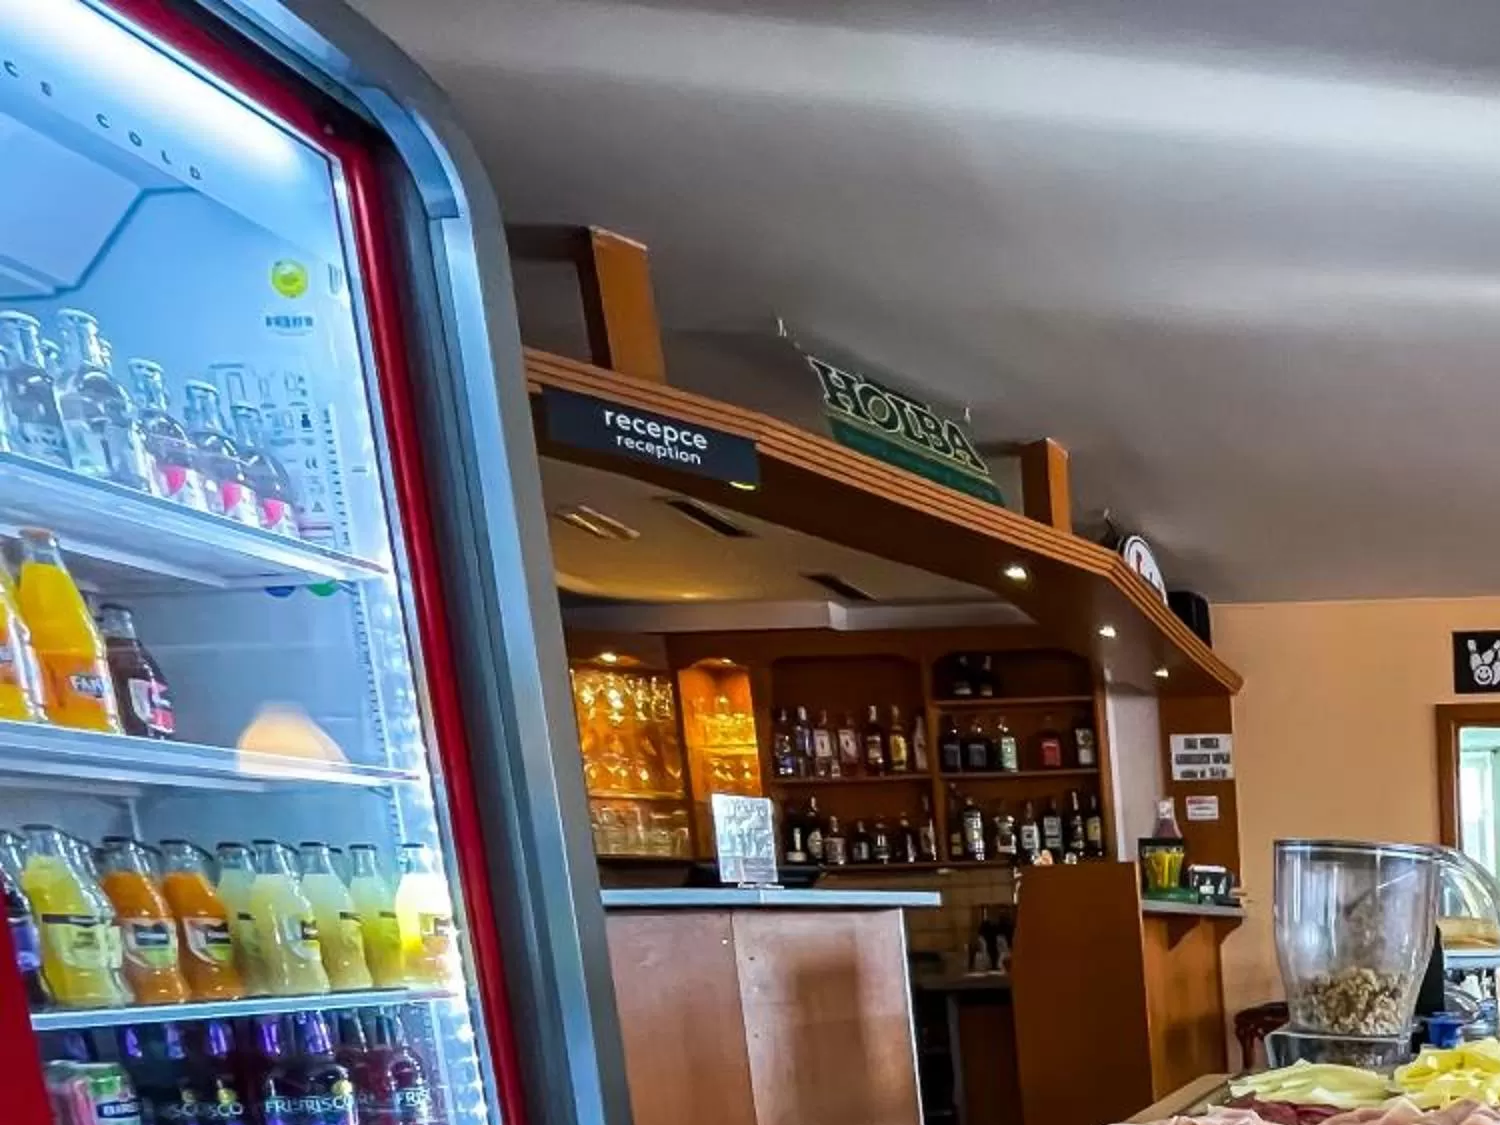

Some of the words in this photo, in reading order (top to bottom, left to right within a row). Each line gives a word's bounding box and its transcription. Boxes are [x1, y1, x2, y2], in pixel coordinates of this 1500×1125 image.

[95, 112, 203, 181] COLD
[604, 410, 708, 449] recepce
[807, 355, 990, 475] HOLBA
[616, 435, 701, 465] reception
